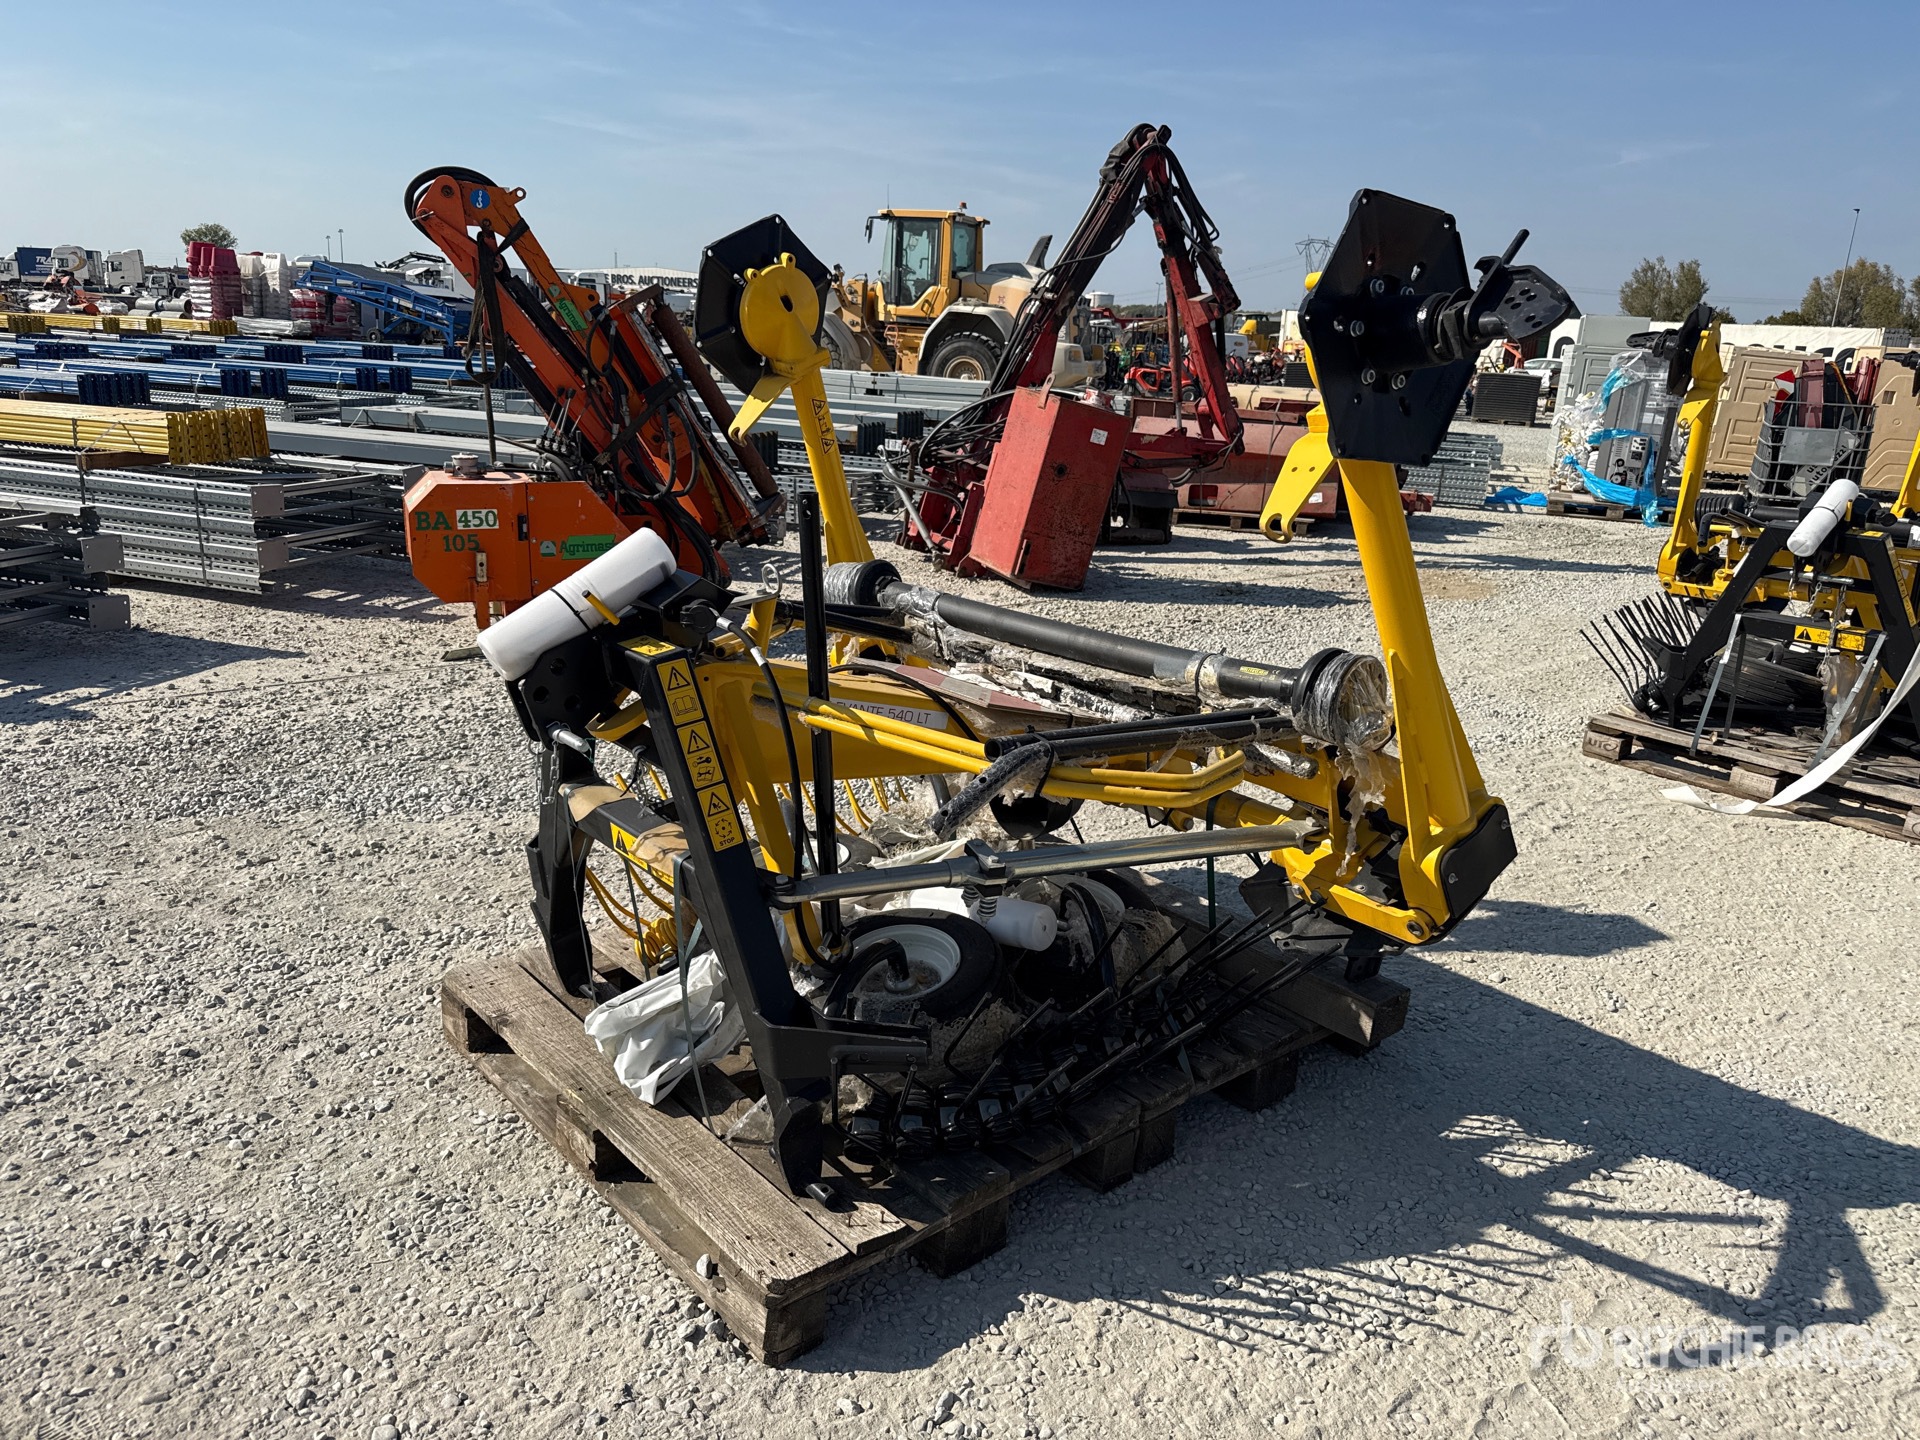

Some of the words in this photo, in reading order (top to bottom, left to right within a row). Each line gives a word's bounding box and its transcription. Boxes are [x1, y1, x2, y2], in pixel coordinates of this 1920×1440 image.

[611, 273, 635, 286] BROS.
[638, 275, 699, 288] AUCTIONEERS
[415, 511, 452, 531] BA
[457, 510, 498, 528] 450
[443, 534, 480, 552] 105
[559, 540, 618, 556] Agrimas
[888, 708, 914, 723] 540
[917, 712, 932, 725] LT
[719, 836, 735, 846] STOP
